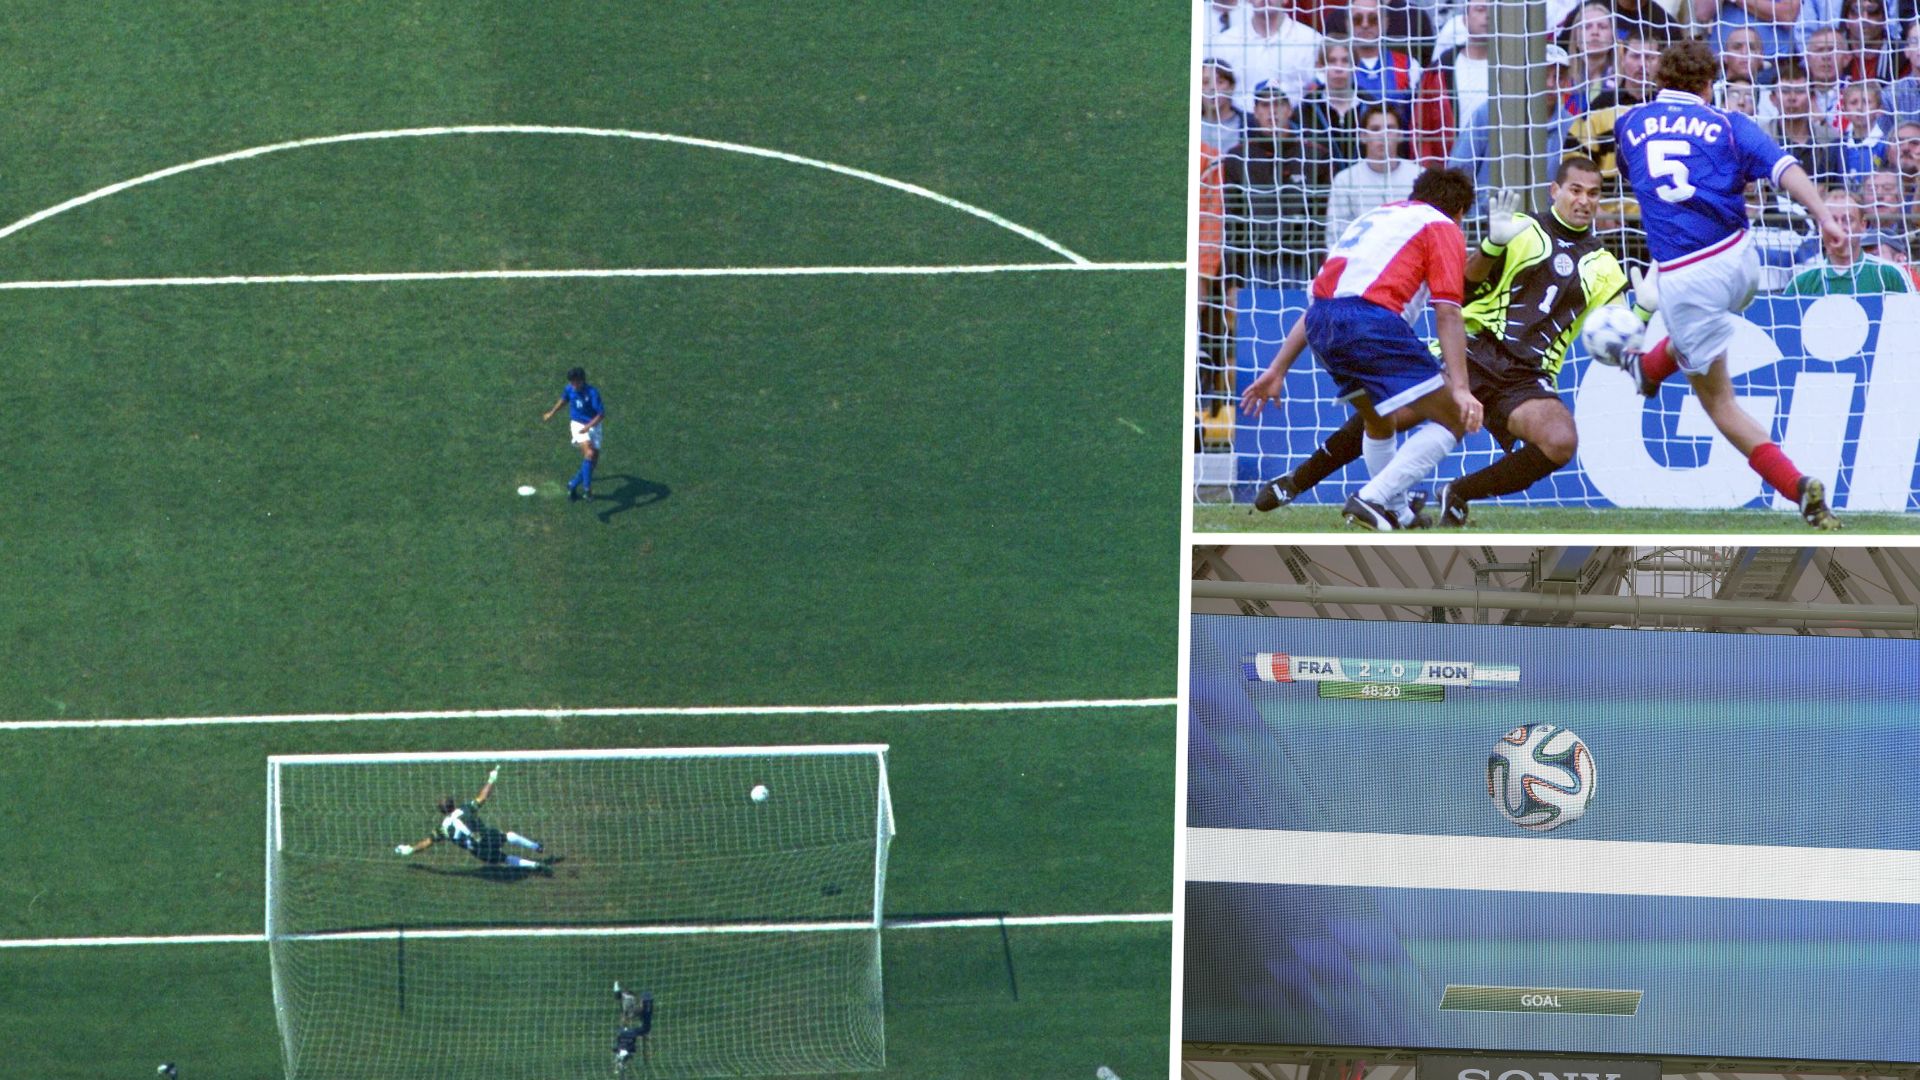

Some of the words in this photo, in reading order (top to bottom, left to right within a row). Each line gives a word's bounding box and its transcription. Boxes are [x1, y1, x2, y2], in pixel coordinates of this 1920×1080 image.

[1646, 139, 1697, 203] 5
[1538, 284, 1559, 314] 1
[1298, 660, 1334, 675] FRA
[1359, 662, 1372, 678] 2
[1391, 663, 1405, 678] 0
[1428, 665, 1468, 680] HON
[1361, 685, 1401, 697] 48:20
[1521, 994, 1562, 1008] GOAL
